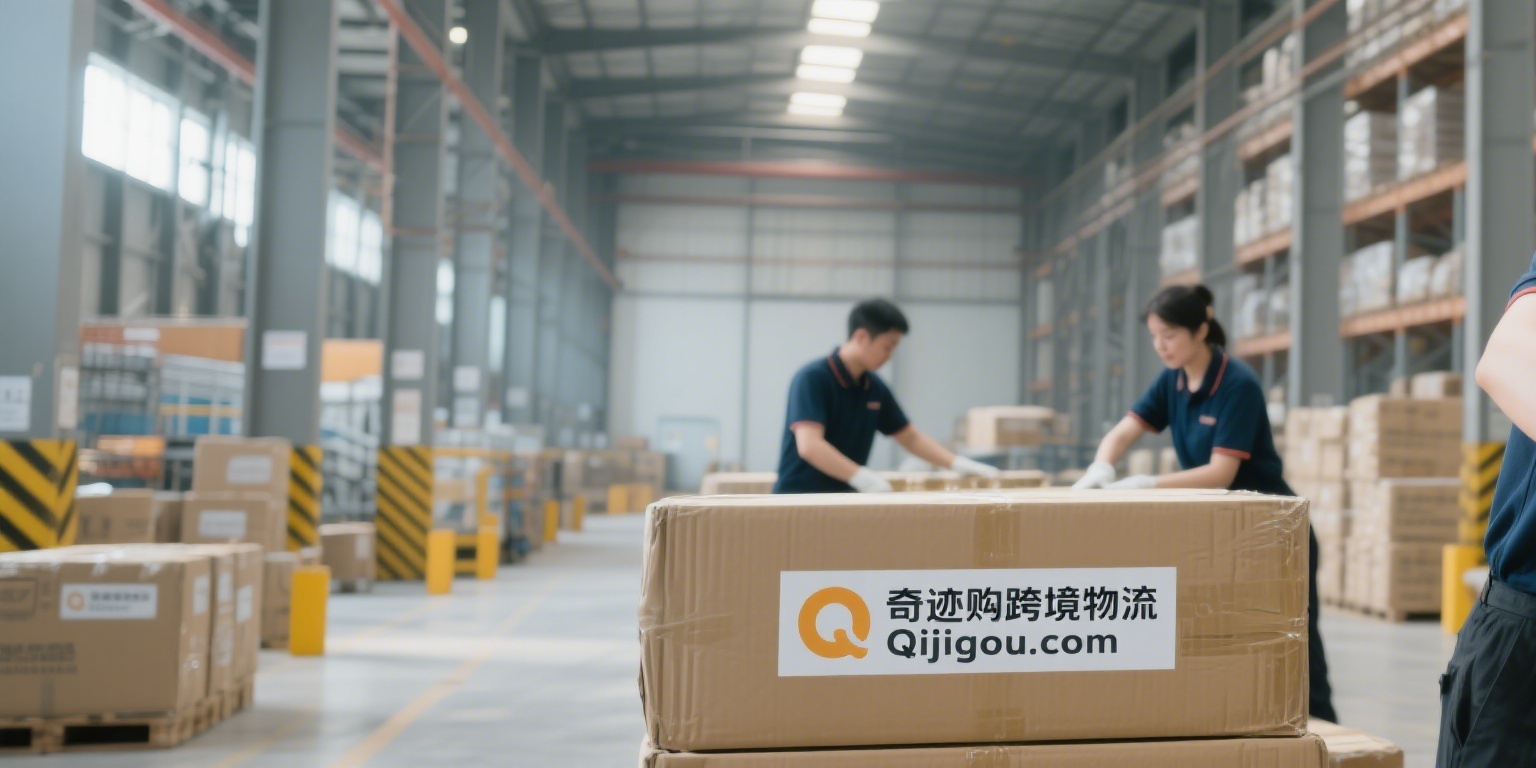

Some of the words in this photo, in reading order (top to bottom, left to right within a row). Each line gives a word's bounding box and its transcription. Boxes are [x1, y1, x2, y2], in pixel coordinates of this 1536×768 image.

[886, 585, 1157, 622] 奇迹购跨境物流
[887, 629, 1117, 663] Qijigou.com
